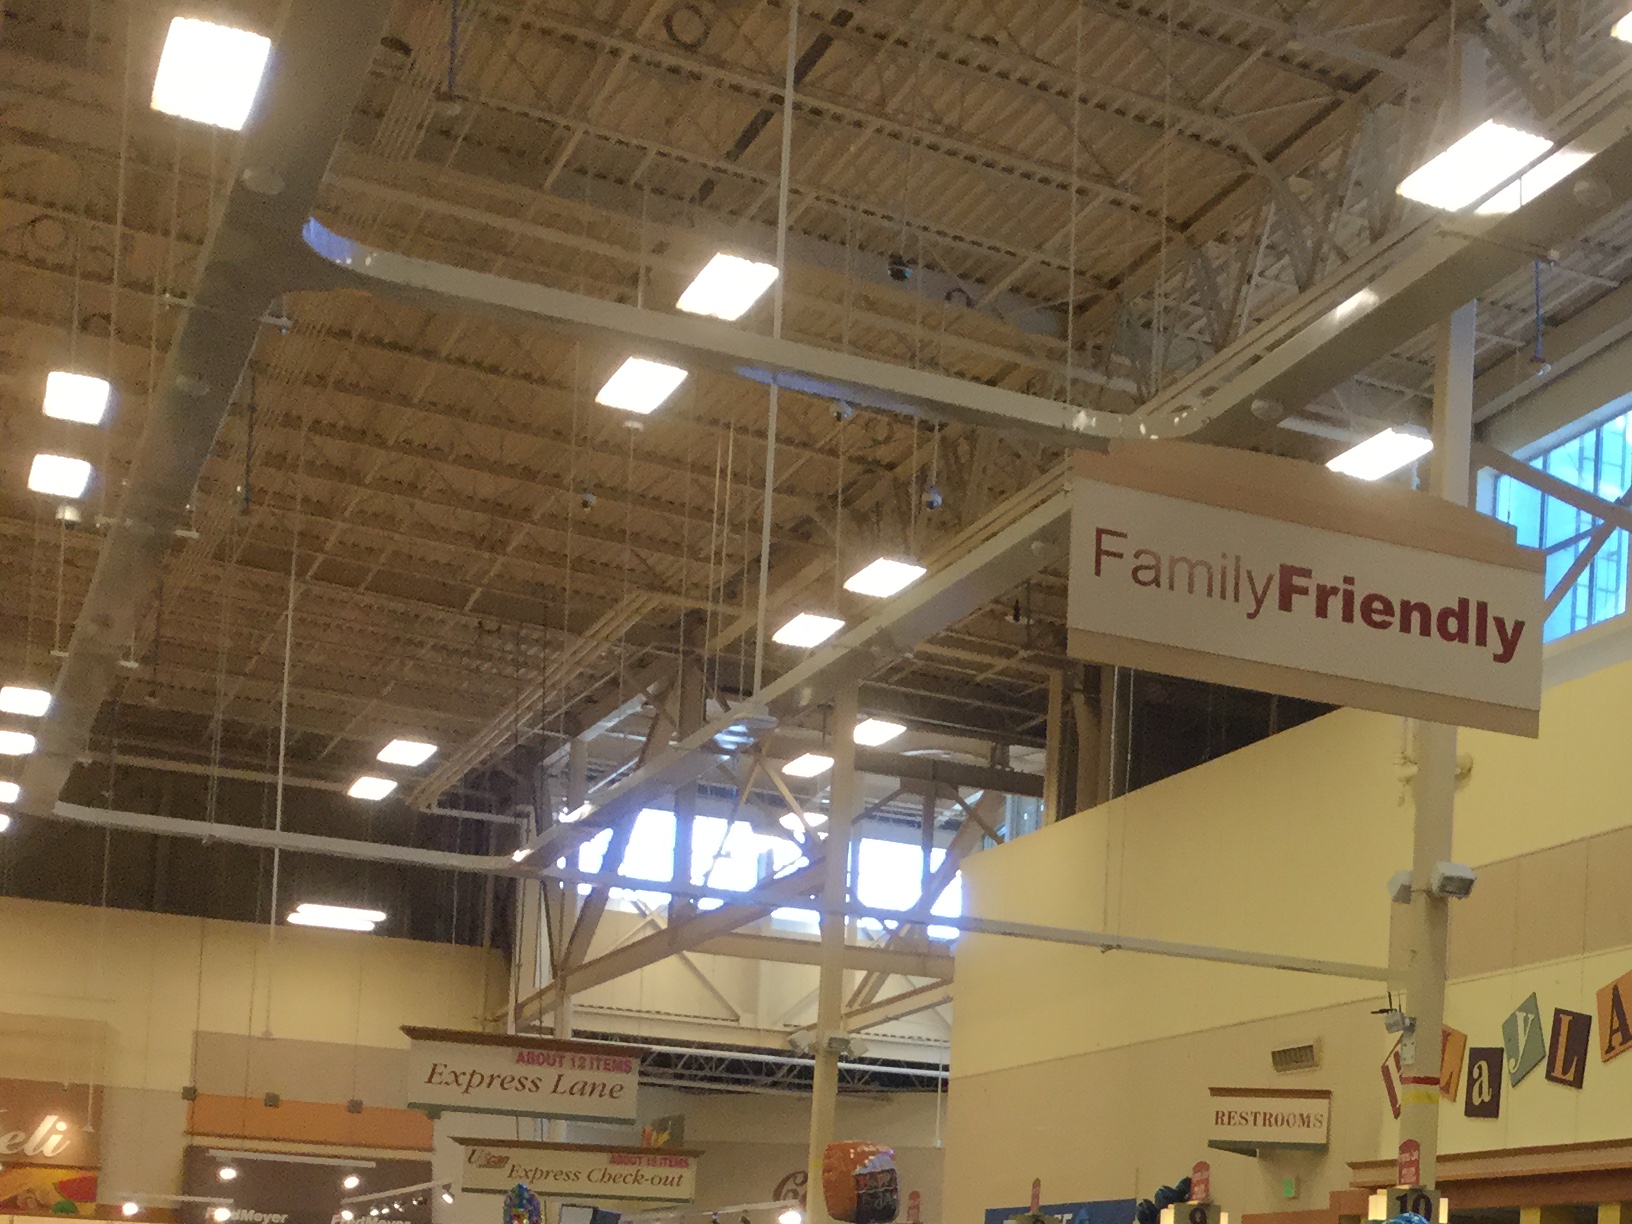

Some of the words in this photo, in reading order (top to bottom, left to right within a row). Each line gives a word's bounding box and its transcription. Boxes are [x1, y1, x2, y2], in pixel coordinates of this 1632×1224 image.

[1093, 526, 1526, 665] FamilyFriendly
[516, 1050, 565, 1068] ABOUT
[569, 1057, 588, 1070] 12
[589, 1057, 633, 1074] ITEMS
[424, 1061, 543, 1094] Express
[550, 1073, 625, 1099] Lane
[1214, 1109, 1325, 1129] RESTROOMS
[0, 1113, 71, 1157] eli
[507, 1163, 581, 1184] Express
[587, 1168, 684, 1188] Check-out
